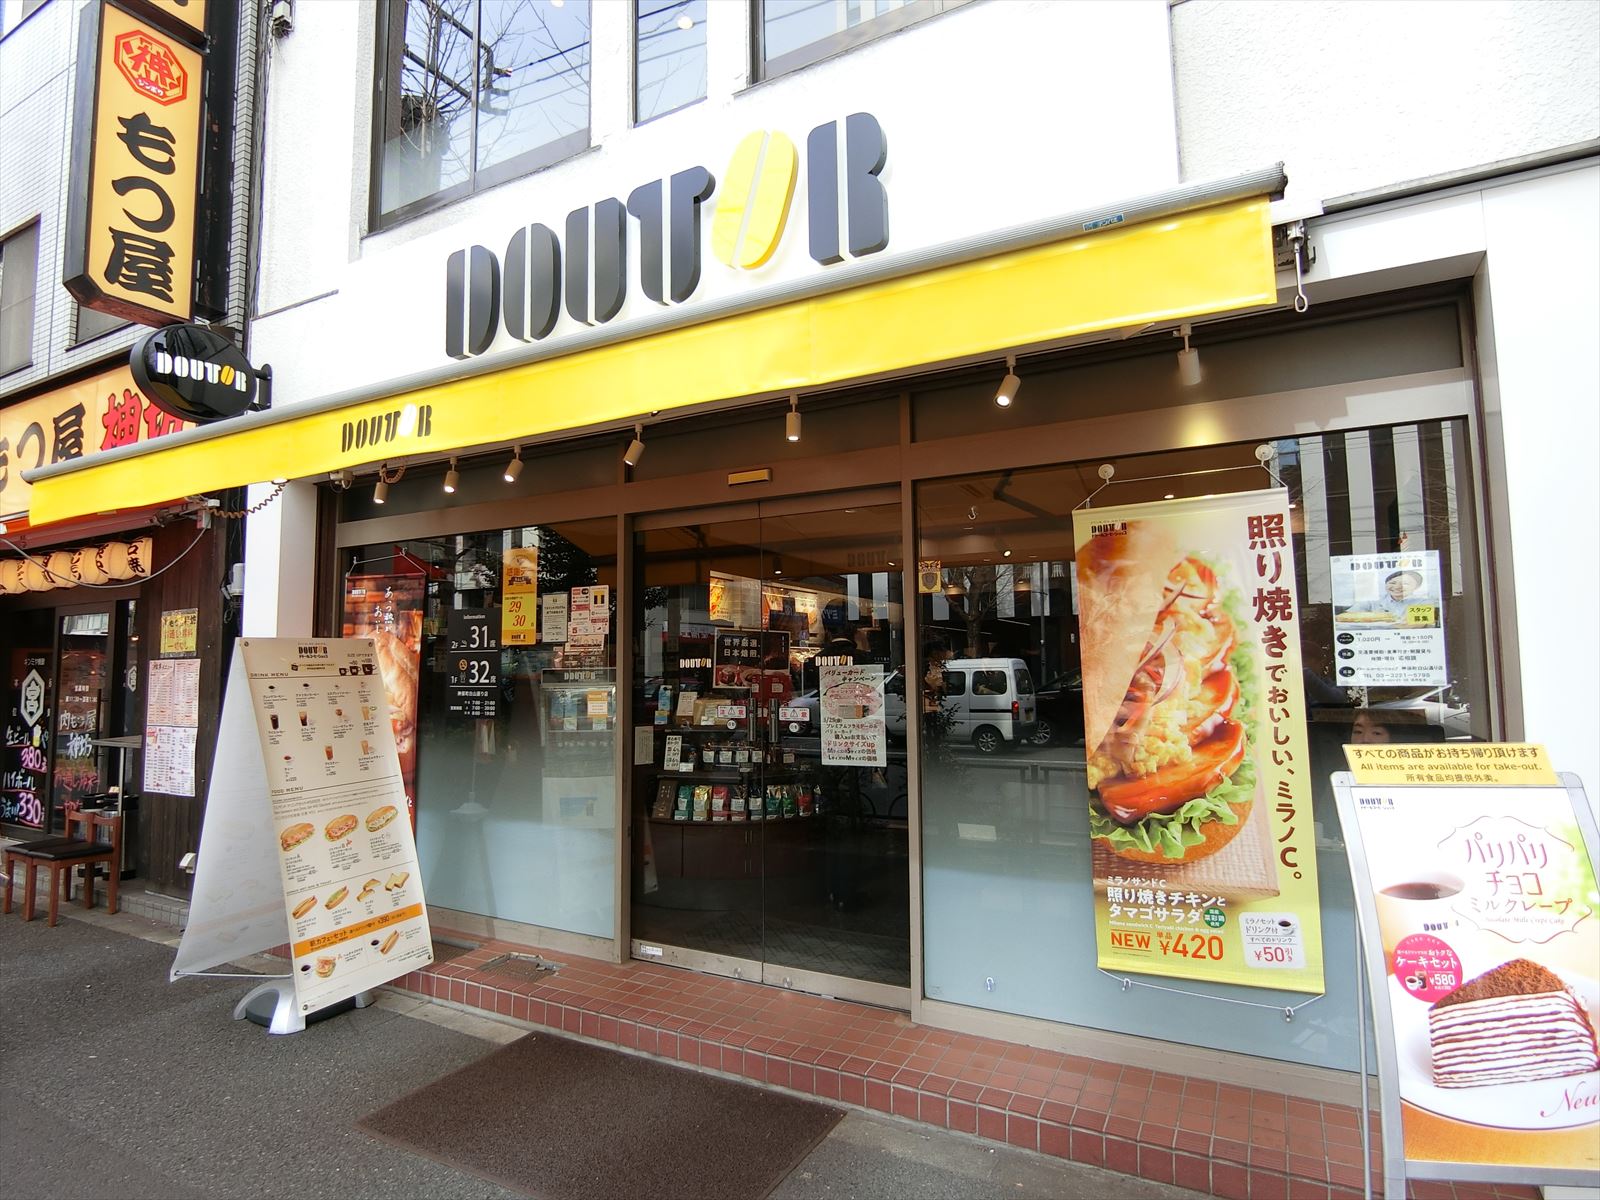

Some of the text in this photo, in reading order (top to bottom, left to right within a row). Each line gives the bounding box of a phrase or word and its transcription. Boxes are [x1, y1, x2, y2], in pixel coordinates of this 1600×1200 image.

[104, 111, 176, 304] もつ屋
[446, 111, 890, 360] DOUTOR
[155, 351, 248, 393] DOUTOR
[341, 402, 432, 454] DOUTOR
[508, 600, 522, 613] 29
[512, 614, 526, 627] 30
[298, 646, 328, 655] DOUTOR
[679, 658, 712, 669] DOUTOR
[815, 655, 853, 667] DOUTOR
[1247, 512, 1302, 880] 照り焼きでおいしい、ミラノC。
[1353, 746, 1539, 759] すべての商品がお持ち帰り頂けます
[1361, 762, 1543, 771] All items are available for take-out.
[2, 768, 37, 791] ハイボール
[1466, 832, 1548, 869] パリパリ
[1107, 876, 1167, 888] ミラノサンドC
[1485, 870, 1543, 896] チョコ
[1107, 886, 1226, 908] 照り焼きチキンと
[1470, 897, 1573, 915] ミルクレープ
[1109, 903, 1203, 925] タマゴサラダ
[1245, 917, 1275, 925] ミラノセット
[1110, 931, 1151, 949] NEW
[1159, 933, 1224, 960] ¥420
[1395, 955, 1457, 969] ケーキセット
[1429, 973, 1455, 986] ¥580
